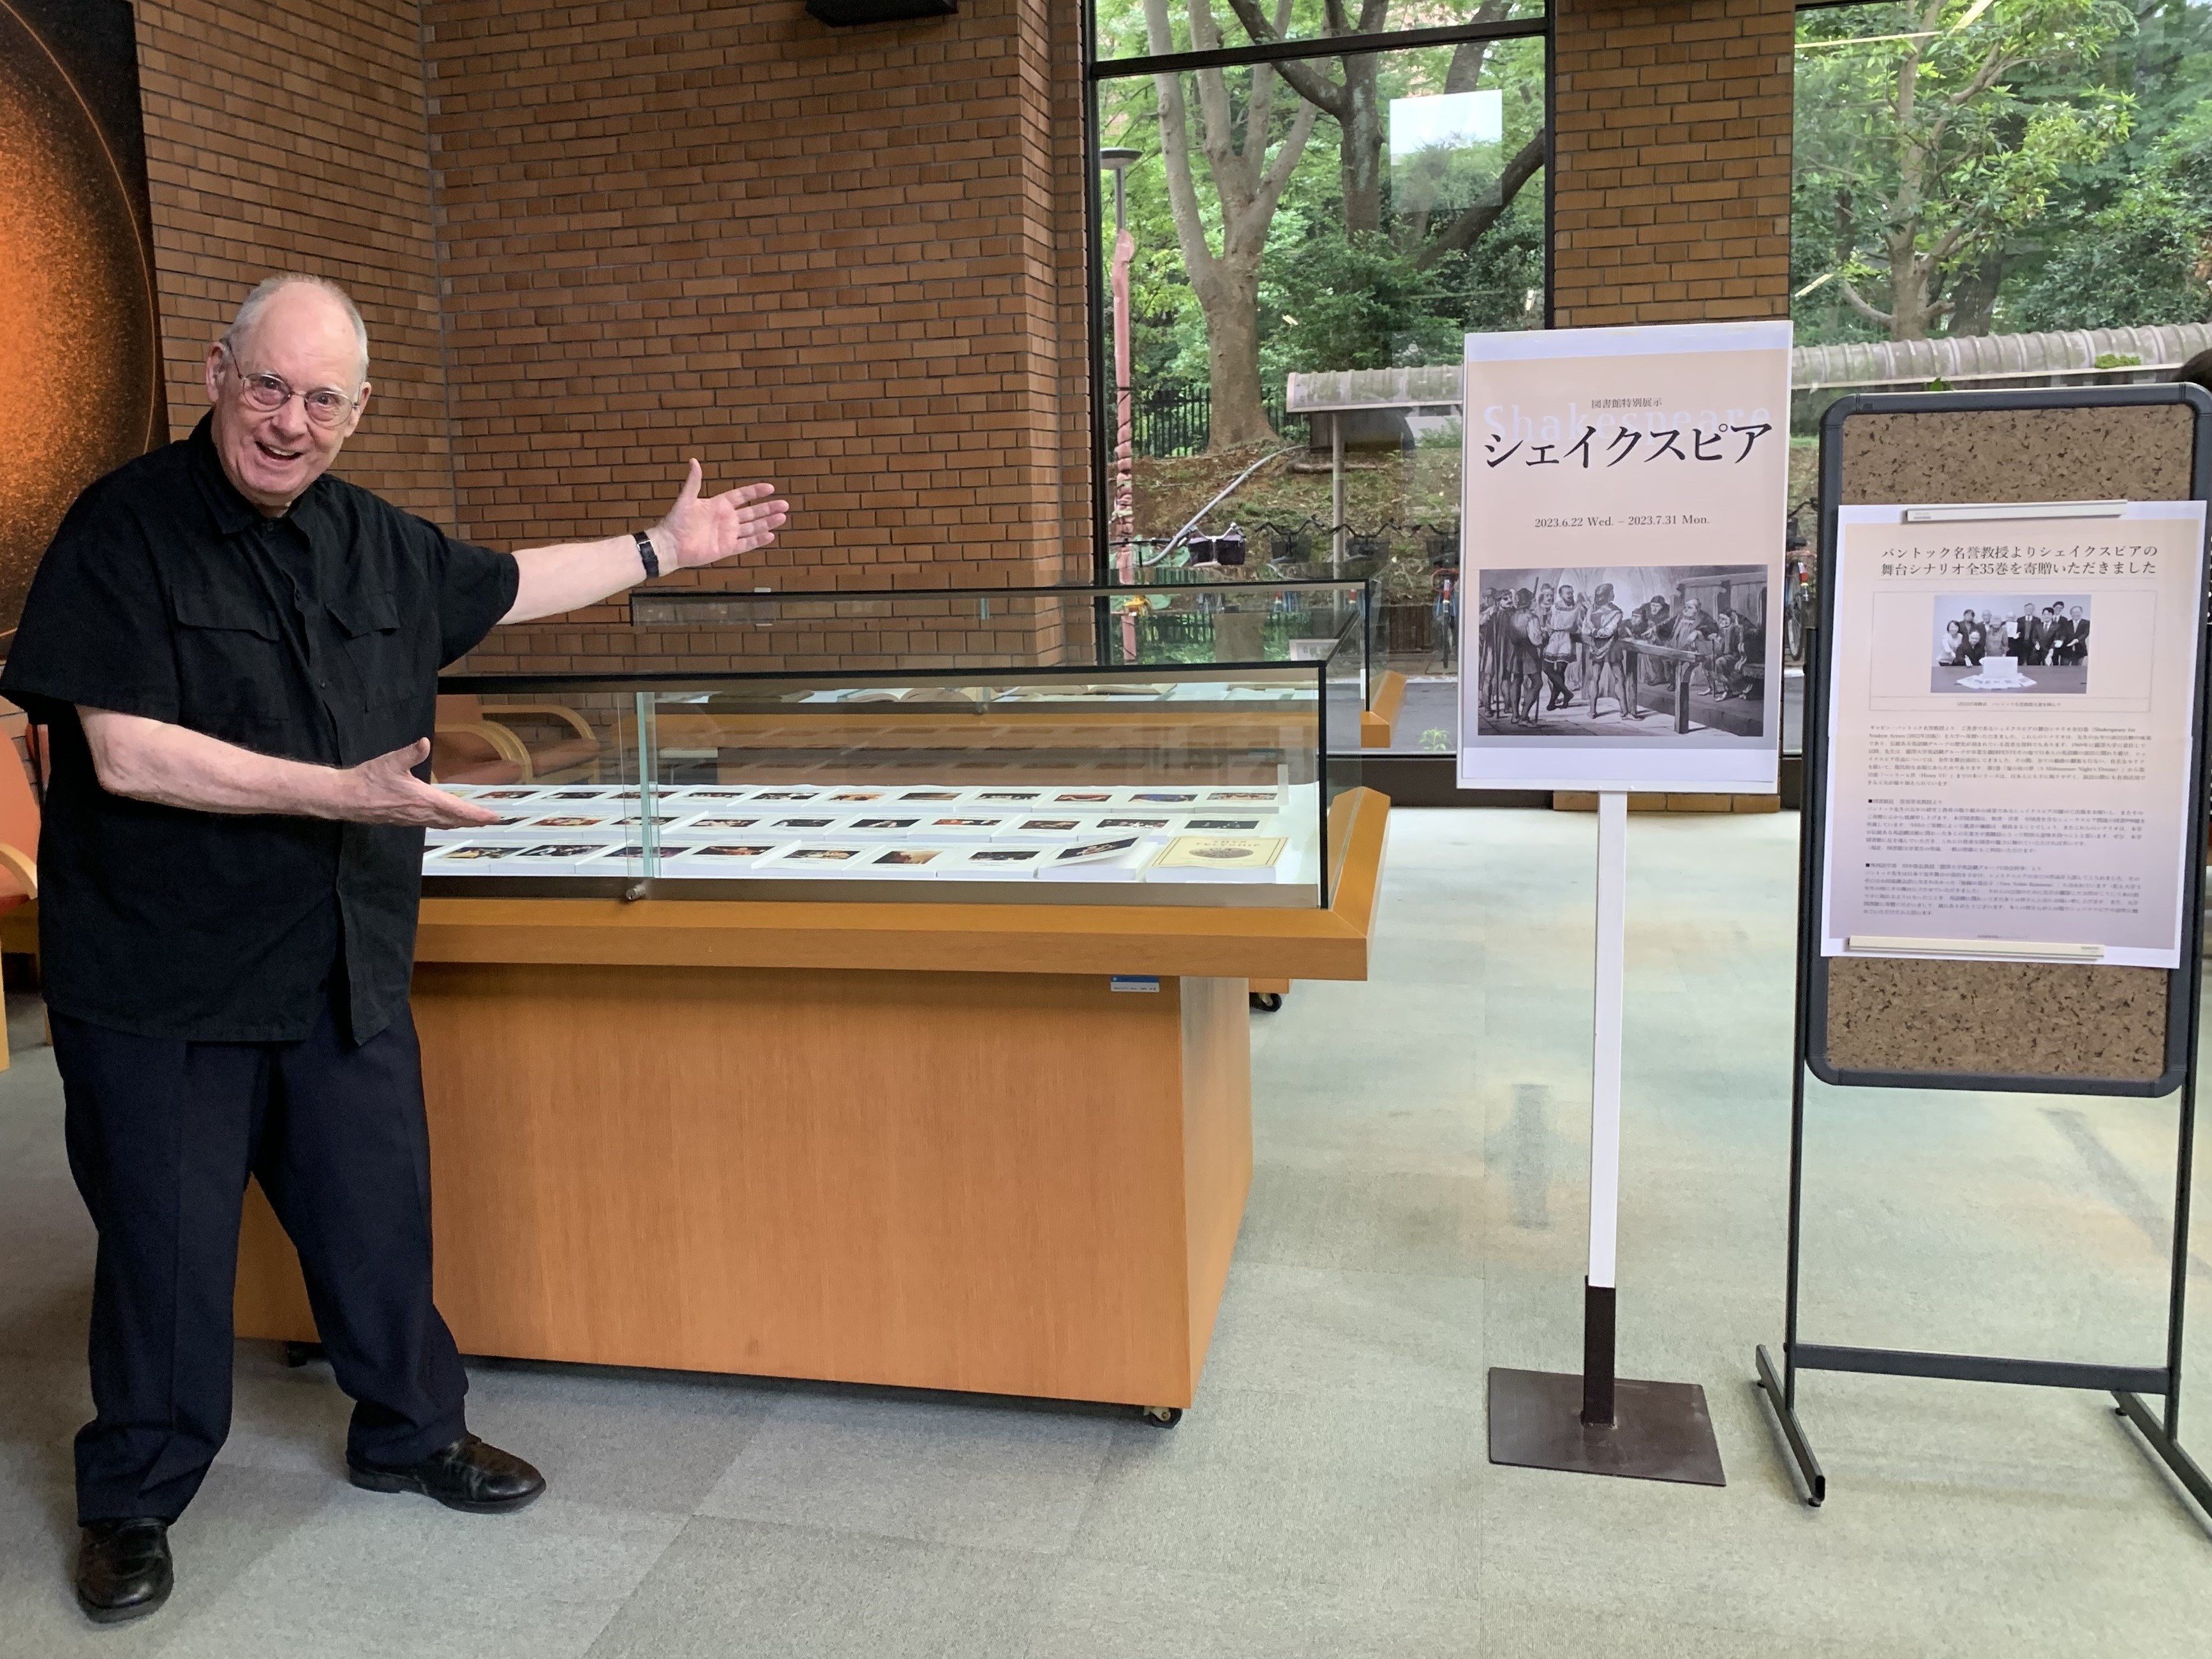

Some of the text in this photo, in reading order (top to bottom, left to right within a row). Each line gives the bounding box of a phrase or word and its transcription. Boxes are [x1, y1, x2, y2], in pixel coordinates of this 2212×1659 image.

[1591, 398, 1663, 409] 図書館特別展示
[1483, 403, 1771, 446] Shakespeare
[1484, 423, 1772, 469] シェイクスピア
[1534, 517, 1584, 528] 2023.6.22
[1587, 516, 1614, 526] Wed.
[1628, 515, 1677, 526] 2023.7.31
[1682, 514, 1710, 524] Mon.
[1882, 545, 2158, 560] バントック名誉教授よりシェイクスピアの
[1881, 561, 2156, 576] 舞台シナリオ全35巻を寄贈いただきました
